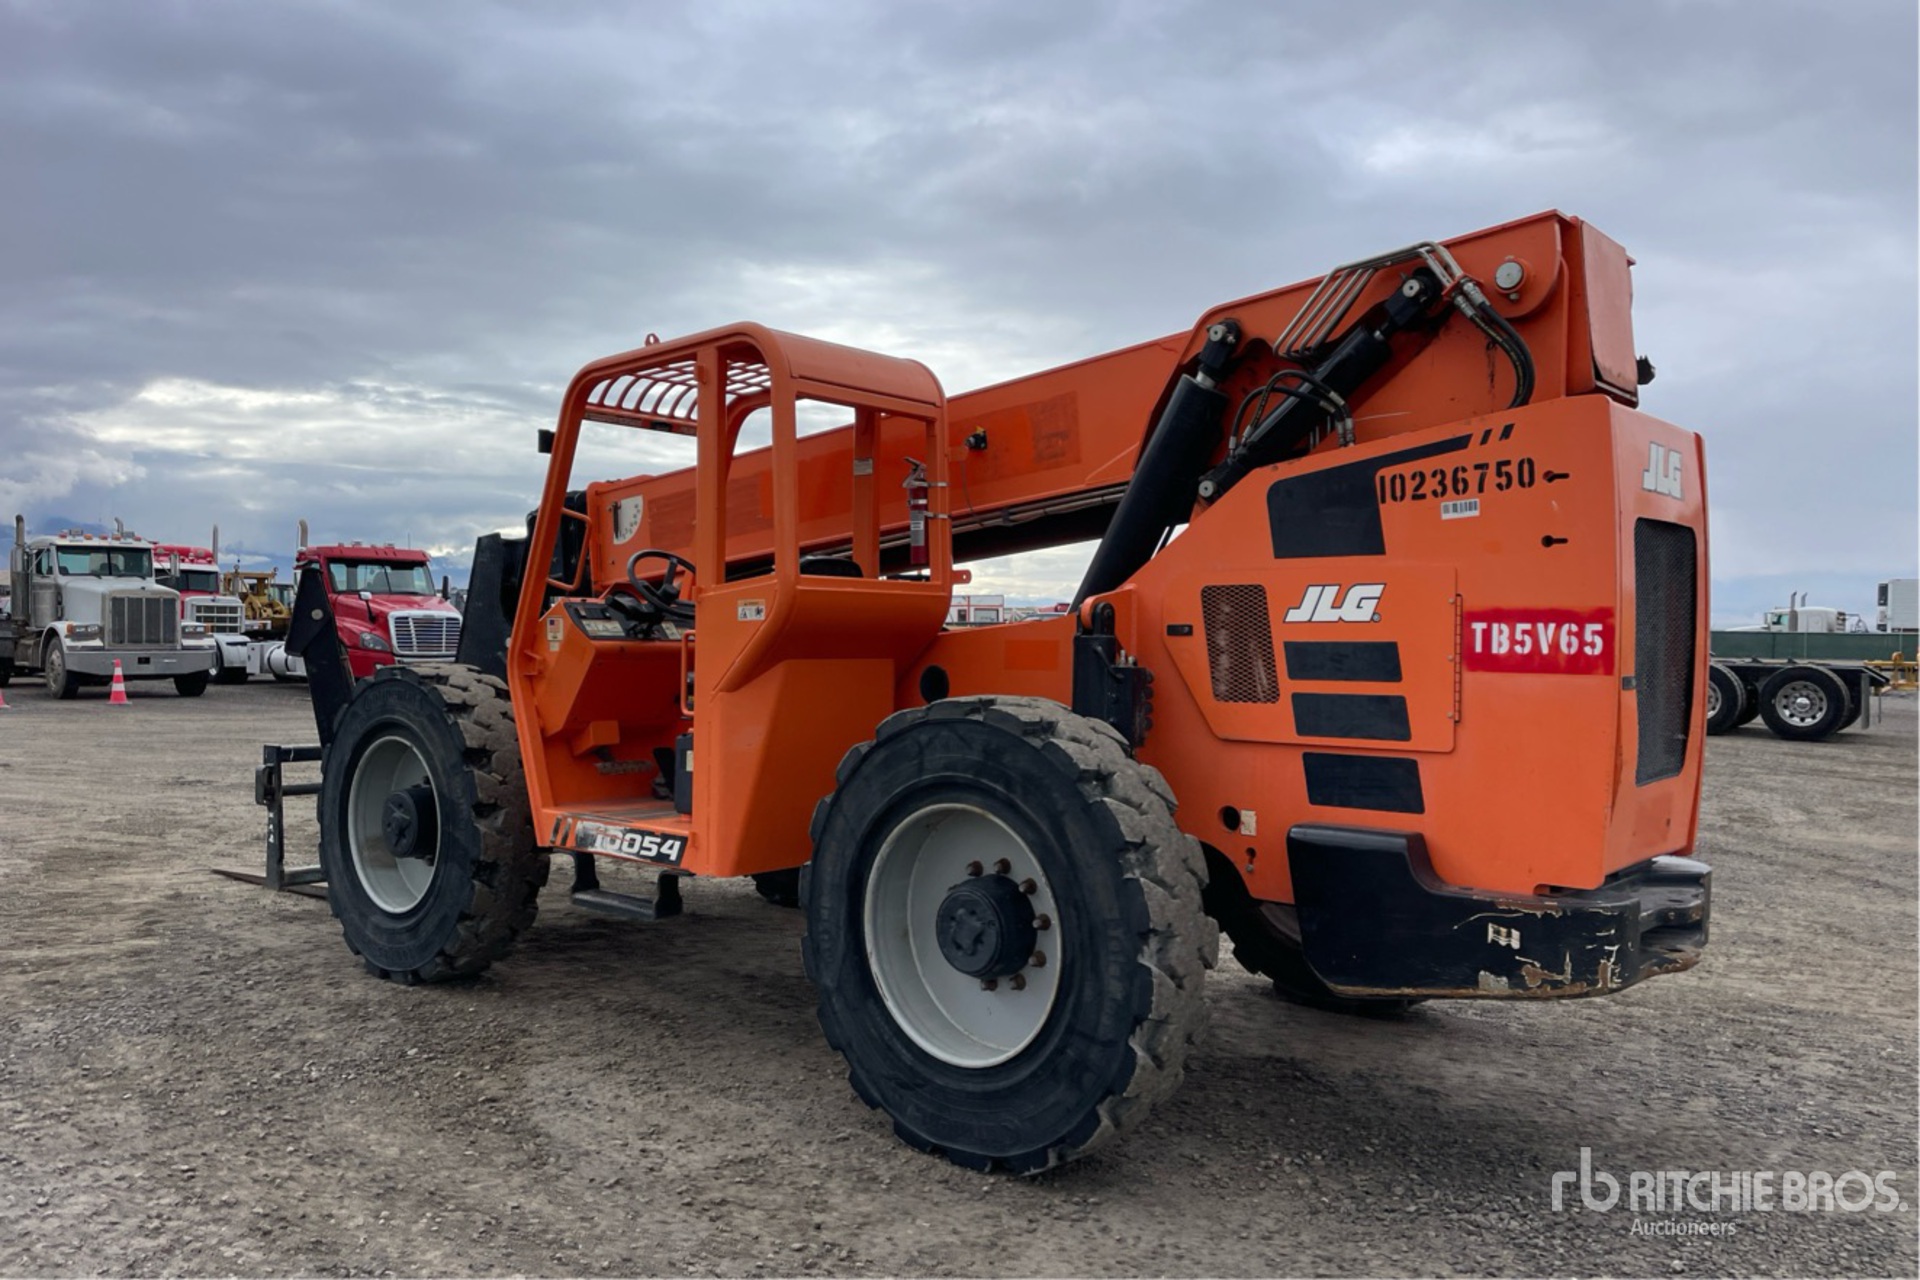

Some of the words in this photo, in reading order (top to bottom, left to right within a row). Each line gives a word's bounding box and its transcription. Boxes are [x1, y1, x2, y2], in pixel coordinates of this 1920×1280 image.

[1379, 457, 1536, 504] 10236750
[1642, 440, 1684, 501] JLG
[1283, 583, 1386, 623] JLG
[1471, 622, 1604, 655] TB5V65
